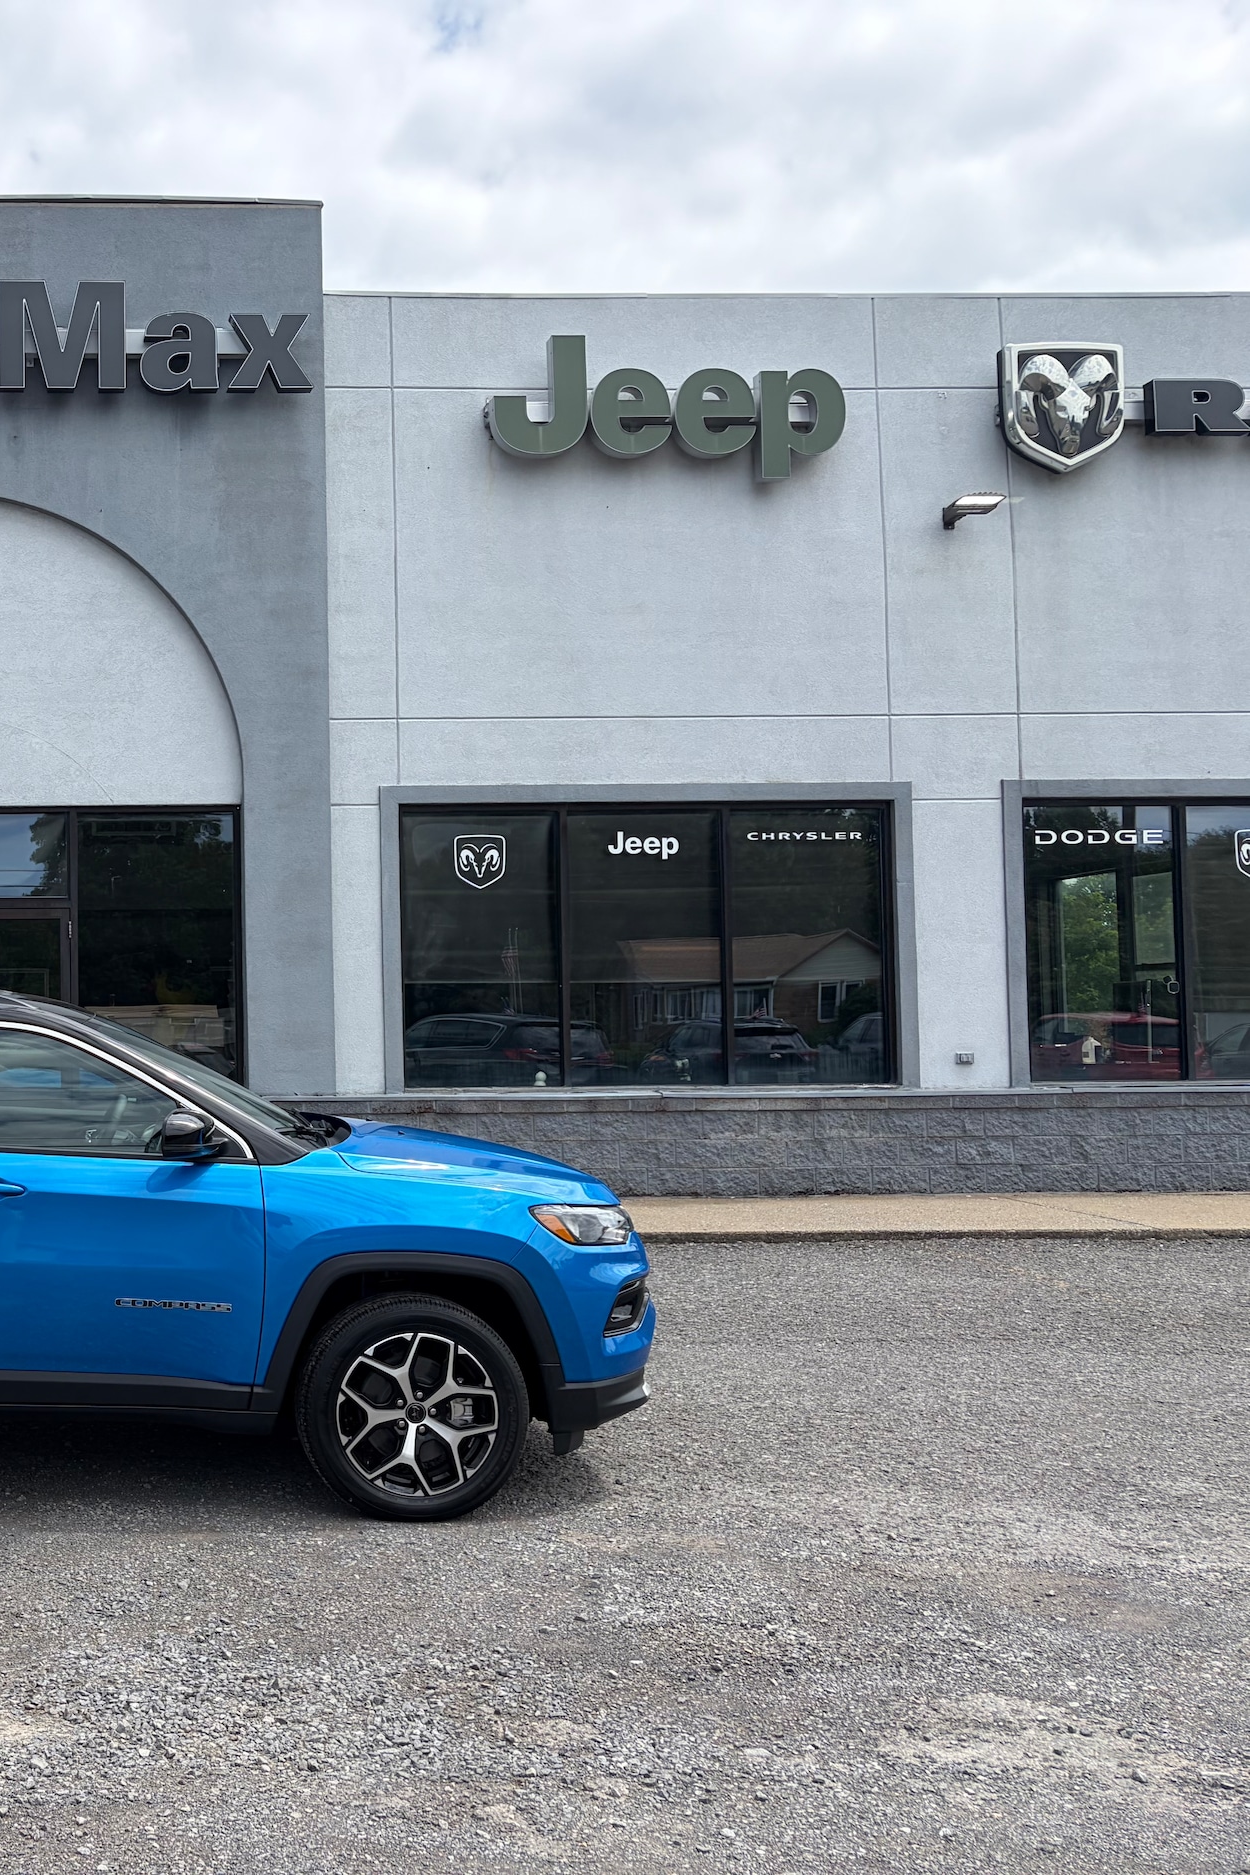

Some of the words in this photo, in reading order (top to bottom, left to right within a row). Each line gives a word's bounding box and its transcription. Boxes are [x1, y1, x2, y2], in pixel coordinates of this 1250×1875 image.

[489, 333, 846, 481] Jeep
[746, 831, 862, 841] CHRYSLER
[1034, 829, 1164, 845] DODGE
[607, 831, 679, 860] Jeep
[115, 1298, 232, 1312] COMPASS
